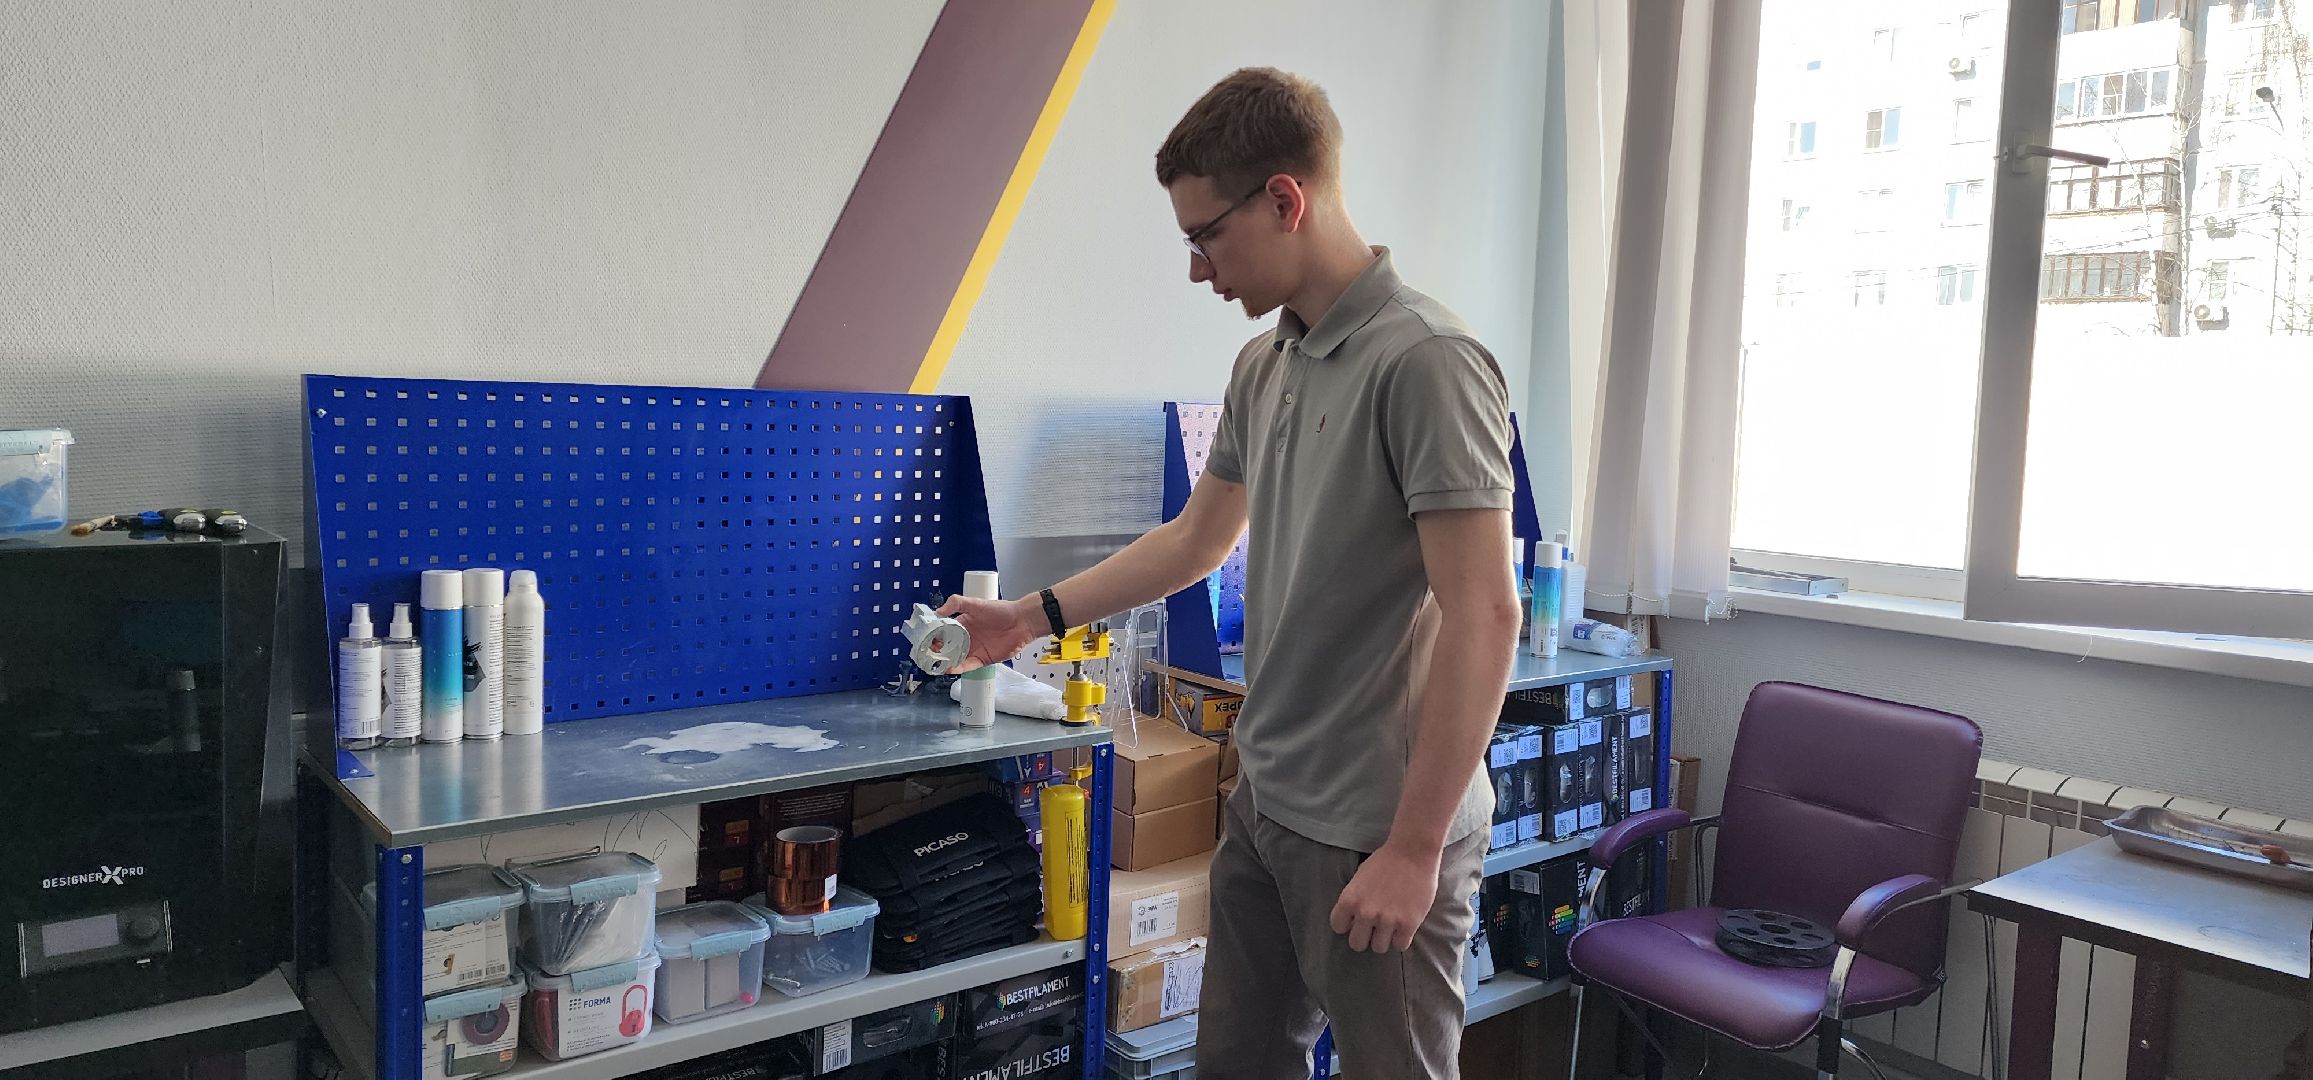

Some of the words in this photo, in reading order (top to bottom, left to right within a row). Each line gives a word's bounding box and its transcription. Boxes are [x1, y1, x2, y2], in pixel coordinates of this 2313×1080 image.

[913, 832, 969, 857] PICASO
[583, 996, 611, 1009] FORMA
[1006, 976, 1070, 1006] BESTFILAMENT
[963, 1045, 1070, 1080] BESTFILAME
